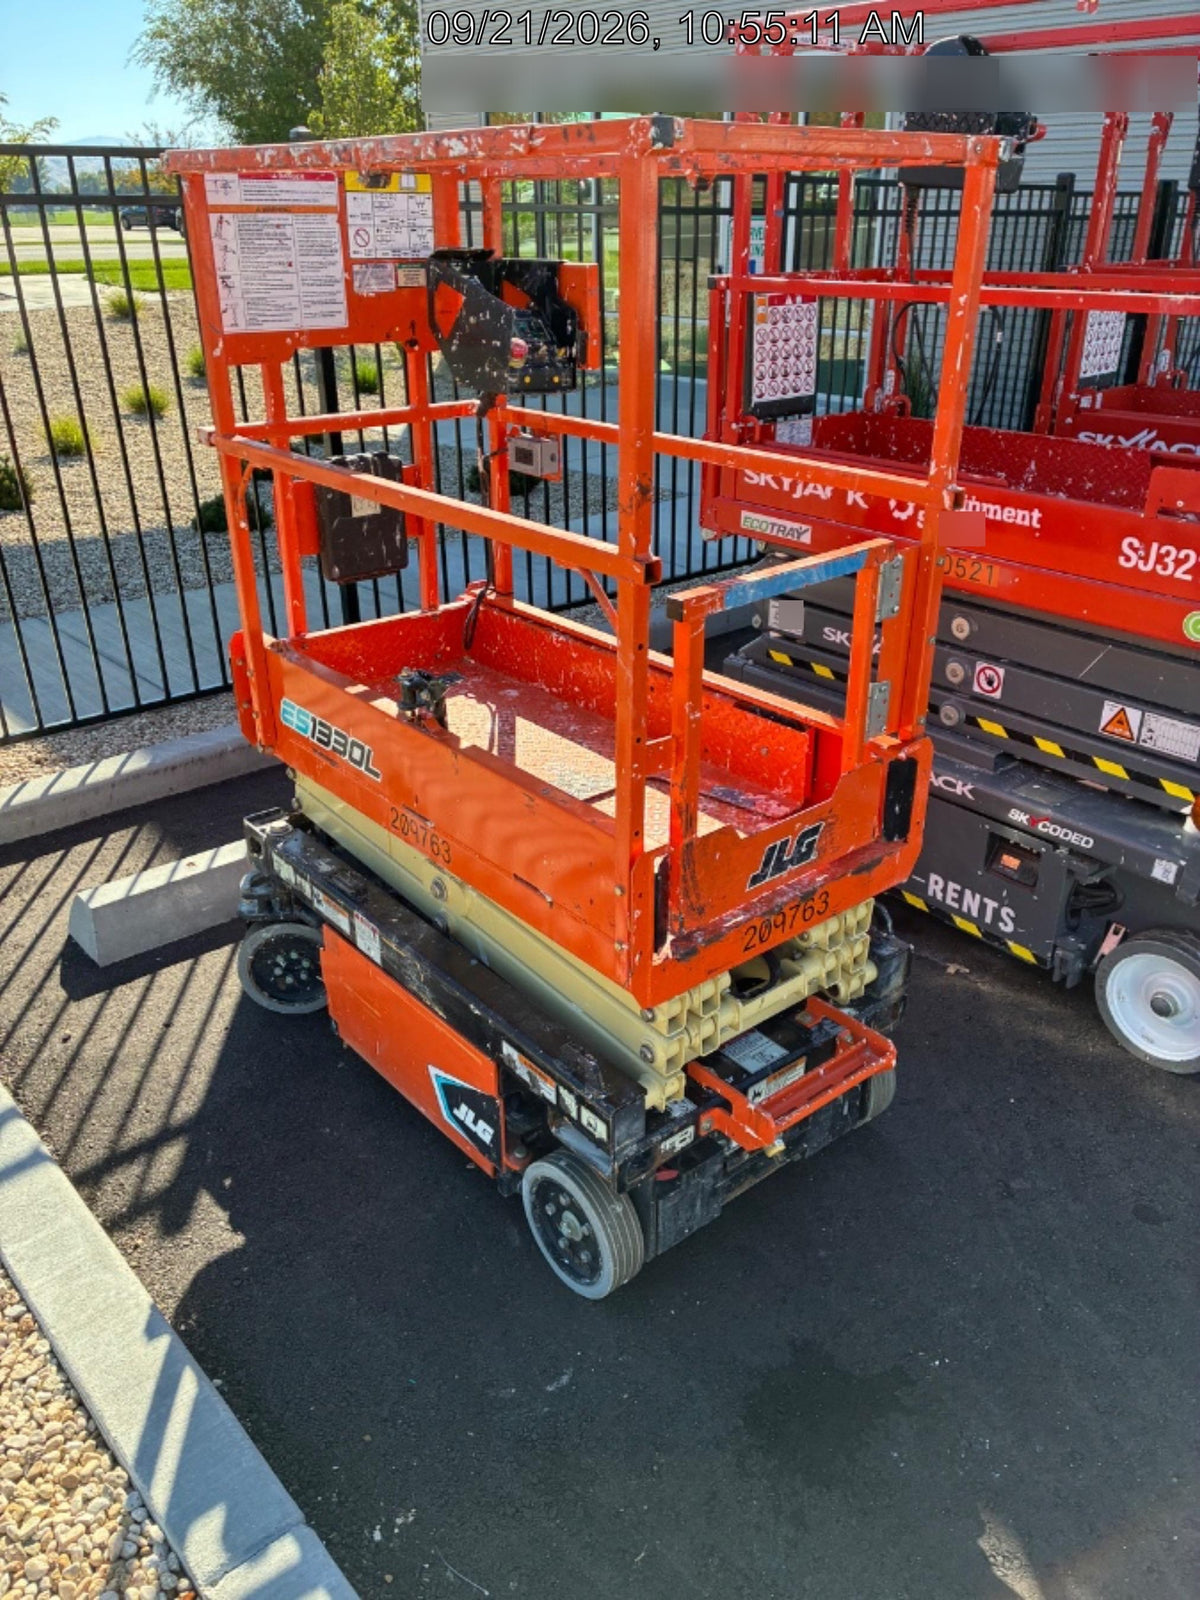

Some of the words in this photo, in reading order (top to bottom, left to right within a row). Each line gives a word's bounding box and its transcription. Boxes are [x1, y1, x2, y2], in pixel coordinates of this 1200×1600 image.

[742, 516, 810, 540] ECOTRAY
[1118, 536, 1200, 581] SJ32
[281, 698, 382, 783] ES1330L
[390, 806, 453, 865] 209763
[745, 820, 826, 892] JLG
[1007, 807, 1095, 849] SKYCODED
[742, 890, 831, 953] 209763
[927, 872, 1017, 933] RENTS
[452, 1102, 495, 1146] JLG
